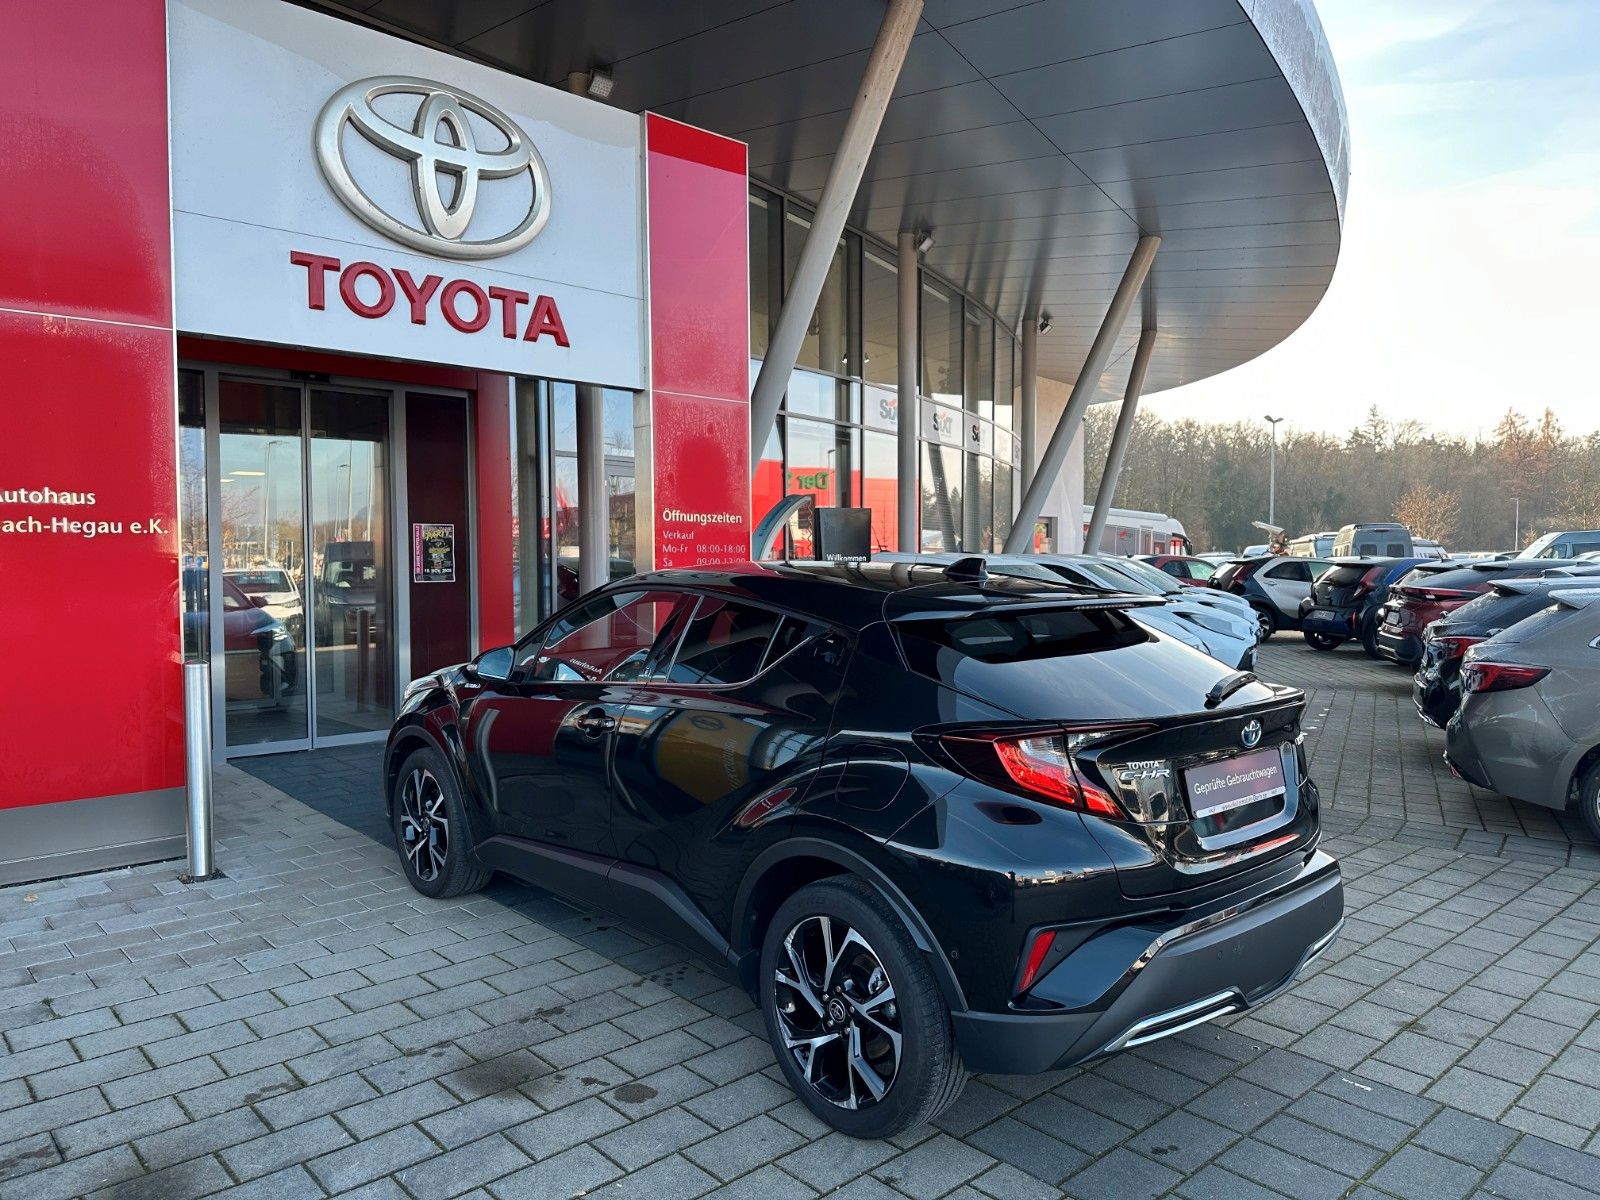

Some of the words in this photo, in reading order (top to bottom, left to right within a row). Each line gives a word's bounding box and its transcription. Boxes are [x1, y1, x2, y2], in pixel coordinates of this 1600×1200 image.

[290, 251, 570, 348] TOYOTA
[662, 508, 742, 526] Öffnungszeiten
[0, 516, 123, 538] ach-Hegau
[129, 518, 169, 534] e.K.
[662, 530, 694, 540] Verkauf
[662, 544, 688, 553] Mo-Fr
[696, 544, 746, 554] 08:00-18:00
[662, 558, 673, 567] Sa
[826, 553, 867, 562] Willkommen
[1126, 761, 1160, 770] TOYOTA
[1119, 769, 1170, 780] C-HR
[1193, 778, 1226, 796] Geprüfte
[1226, 765, 1278, 787] Gebrauchtwagen
